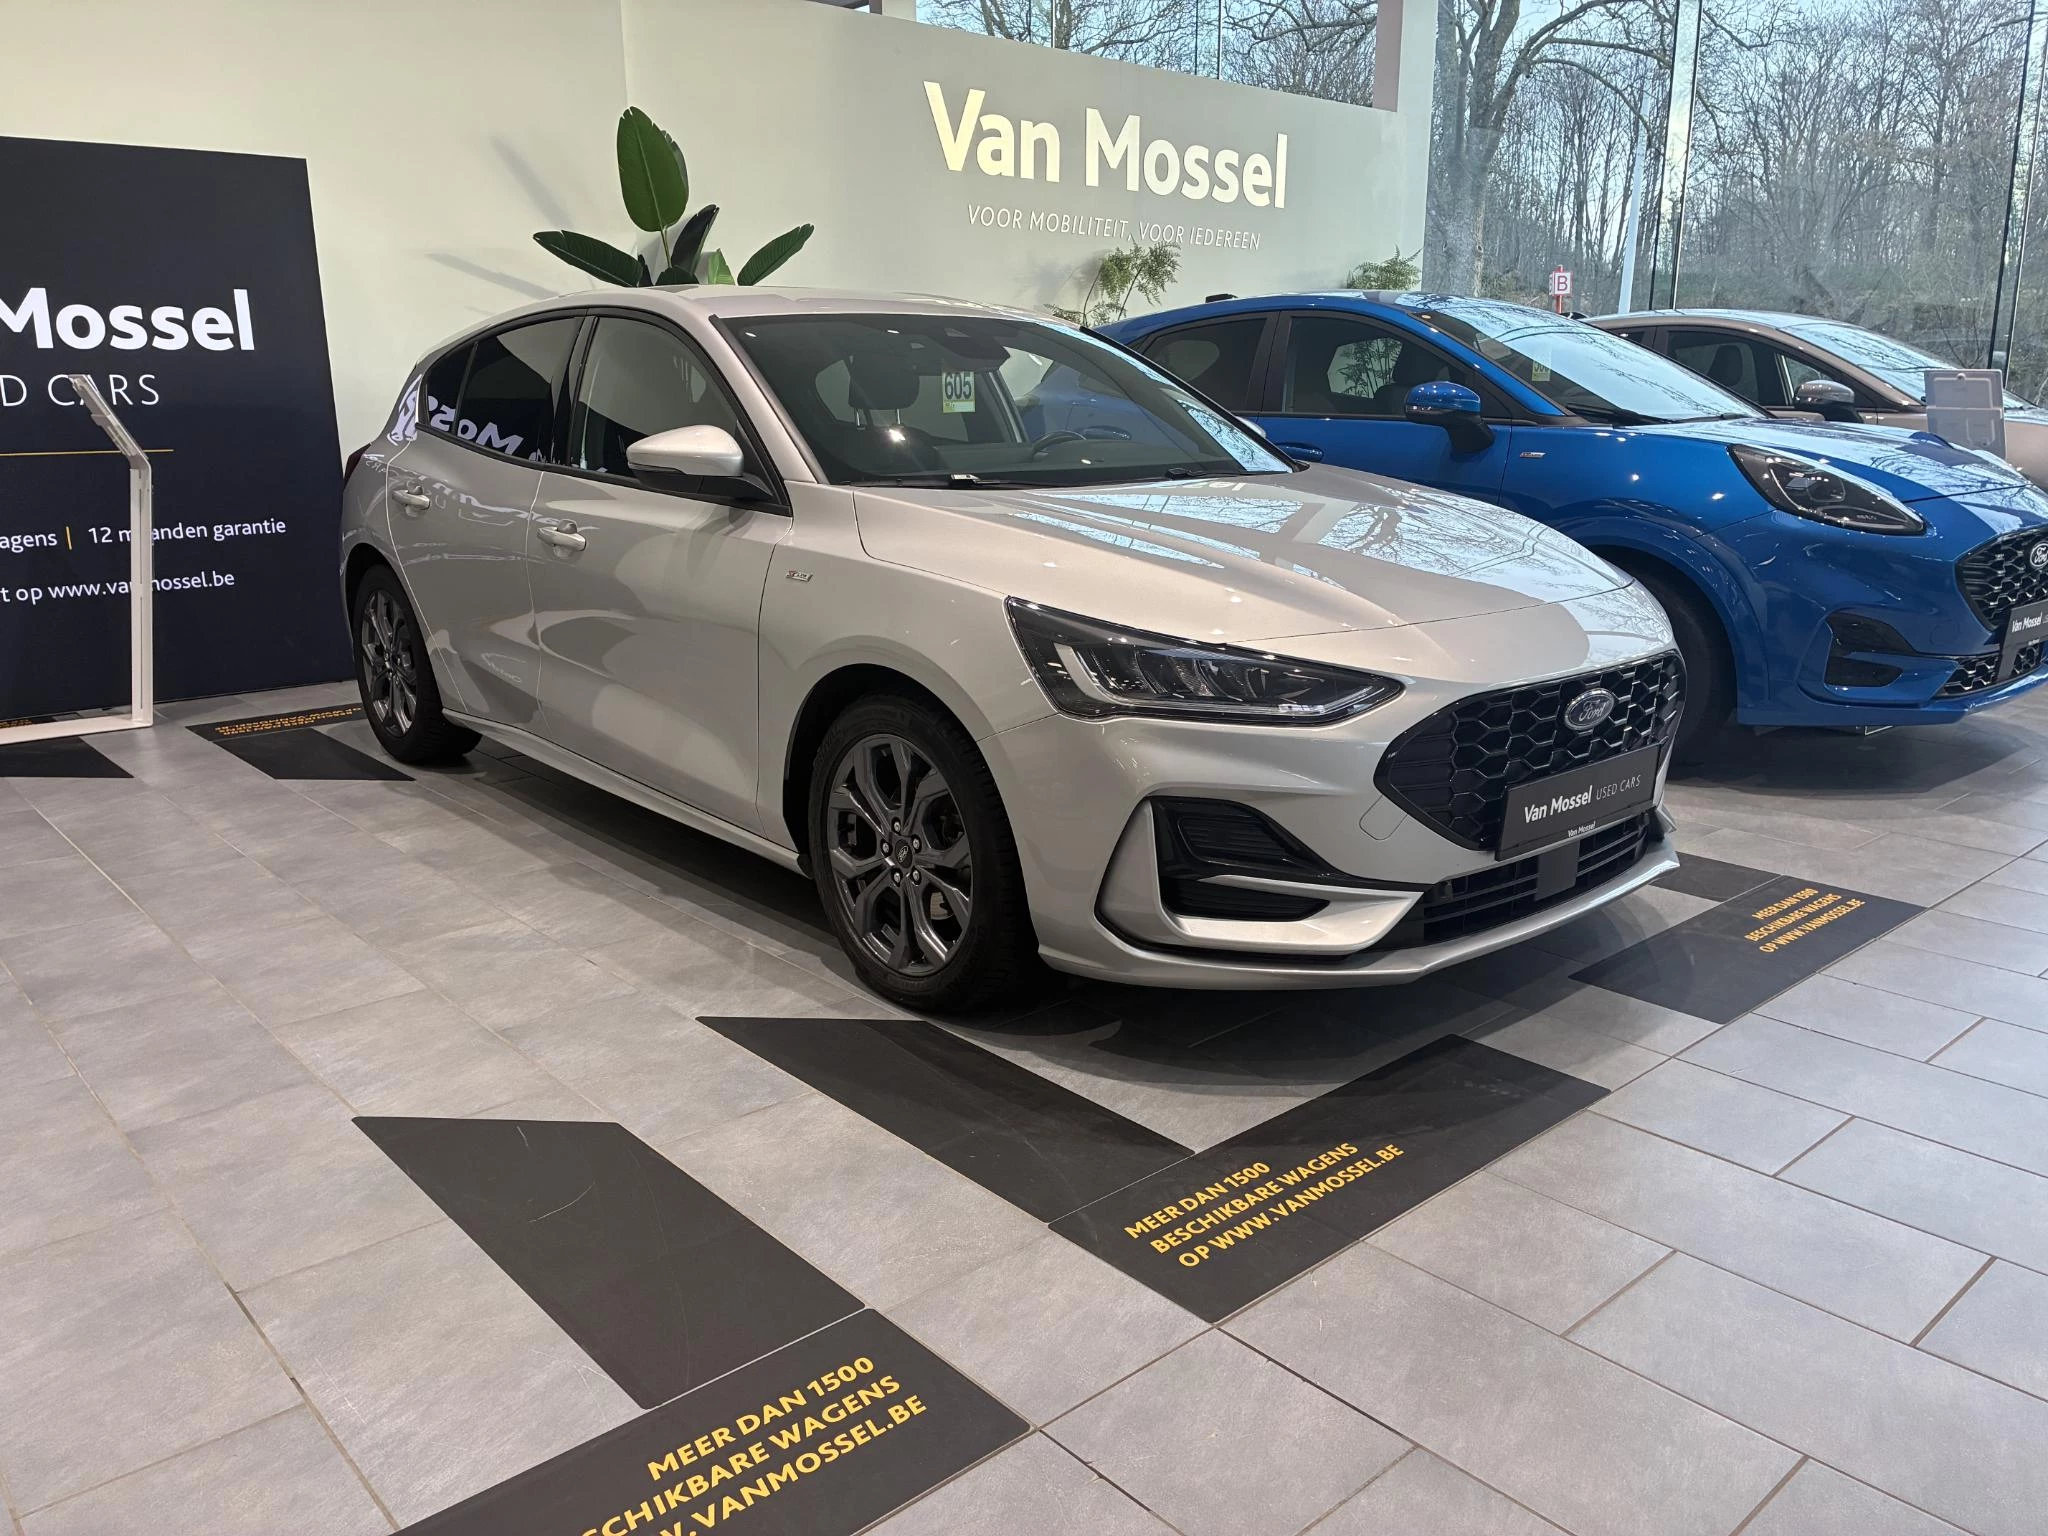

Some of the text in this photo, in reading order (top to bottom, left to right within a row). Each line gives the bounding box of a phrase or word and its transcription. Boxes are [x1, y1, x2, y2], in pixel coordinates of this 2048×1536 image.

[923, 80, 1288, 209] Van Mossel
[967, 204, 1261, 251] VOOR MOBILITEIT, VOOR IEDEREEN
[1557, 275, 1568, 291] B
[0, 287, 255, 351] Mossel
[944, 371, 972, 400] 605
[88, 526, 113, 544] 12
[118, 521, 208, 543] manden
[212, 517, 287, 541] garantie
[15, 586, 43, 605] op
[47, 570, 236, 599] www.vaossel.be
[2012, 619, 2023, 633] Van
[2022, 611, 2043, 630] Mossel
[1524, 774, 1642, 824] Van Mossel USED CARS
[1567, 820, 1596, 838] Van Mossel
[1759, 941, 1779, 953] OP
[1123, 1161, 1271, 1239] MEER DAN 1500
[1150, 1142, 1359, 1254] BESCHIKBARE WAGENS
[1178, 1143, 1405, 1268] OP WWW.VANMOSSEL.BE
[647, 1356, 875, 1481] MEER DAN 1500
[768, 1374, 901, 1450] WAGENS
